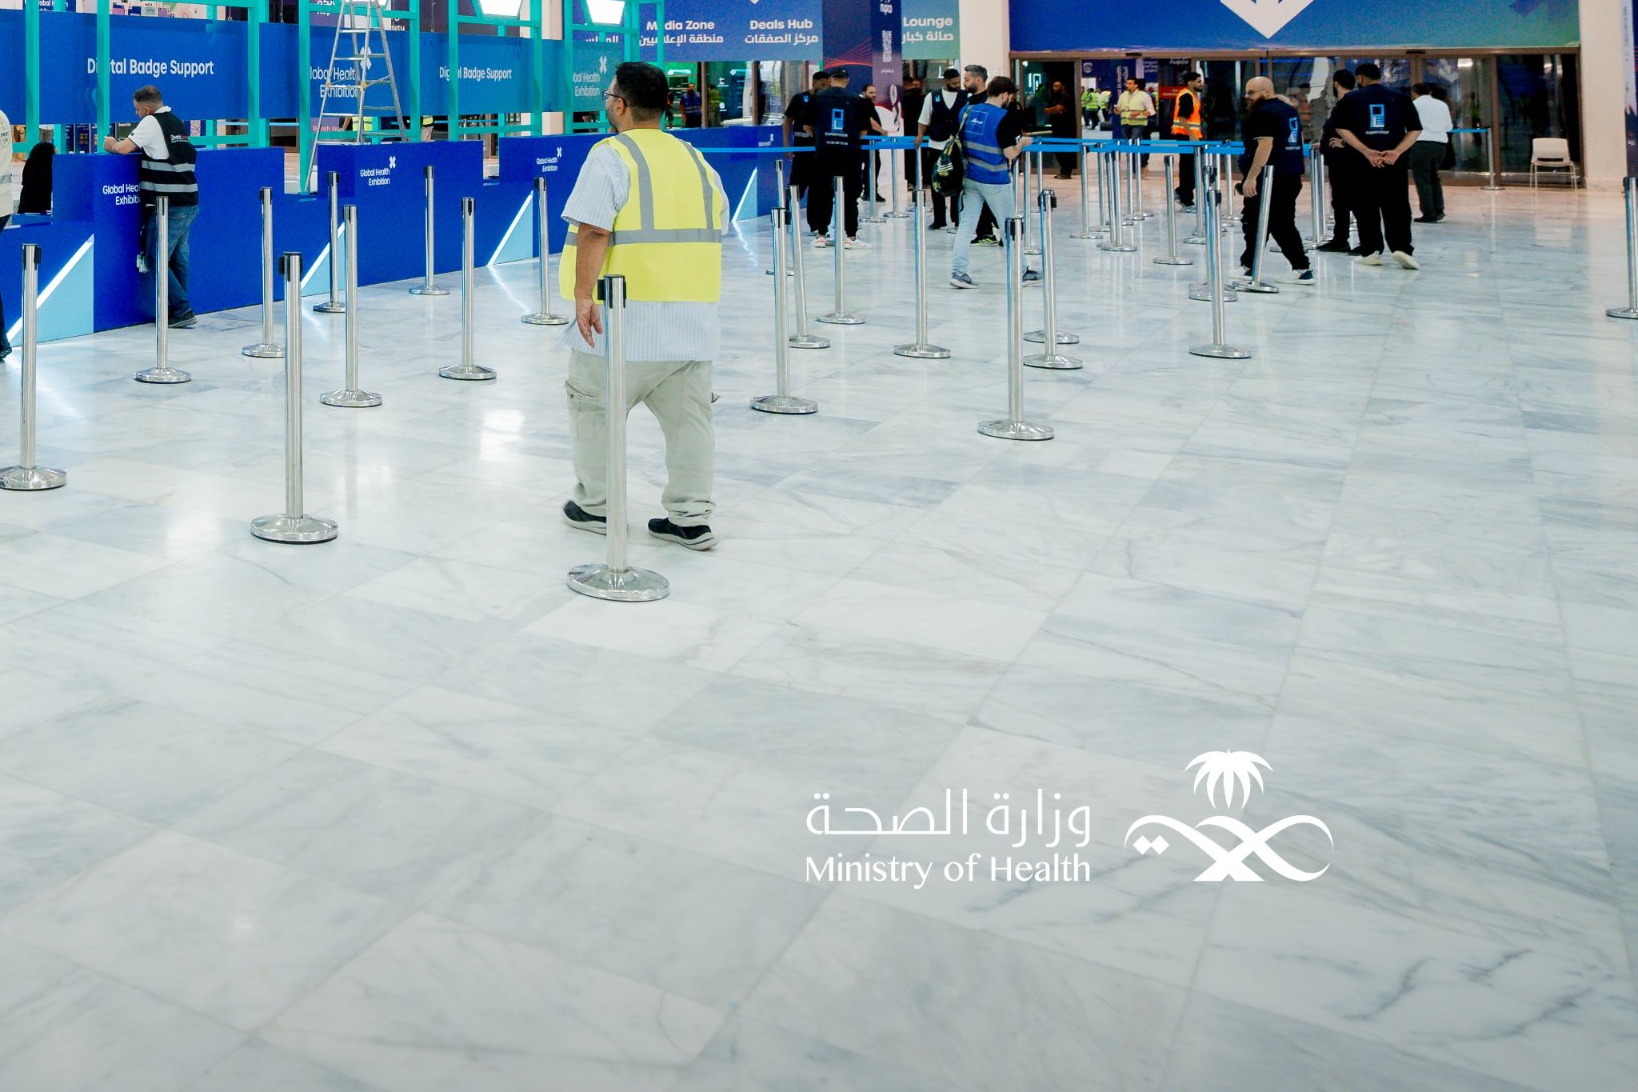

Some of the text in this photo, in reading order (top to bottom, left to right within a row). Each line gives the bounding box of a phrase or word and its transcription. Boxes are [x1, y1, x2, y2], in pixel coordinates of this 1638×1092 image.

[646, 20, 715, 30] Mdia Zone
[749, 19, 813, 30] Deals Hub
[903, 16, 954, 28] Lounge
[688, 33, 724, 44] منطقة
[744, 32, 818, 46] مركز الصفقات
[901, 31, 954, 45] صالة كبار
[129, 58, 167, 78] Badge
[170, 60, 214, 78] Support
[463, 67, 513, 82] Badge Support
[583, 72, 601, 82] Health
[574, 85, 601, 97] Exhibition
[360, 167, 390, 178] Global Health
[542, 164, 558, 172] Exhibition
[368, 177, 390, 187] Exhibition
[102, 184, 125, 195] Global
